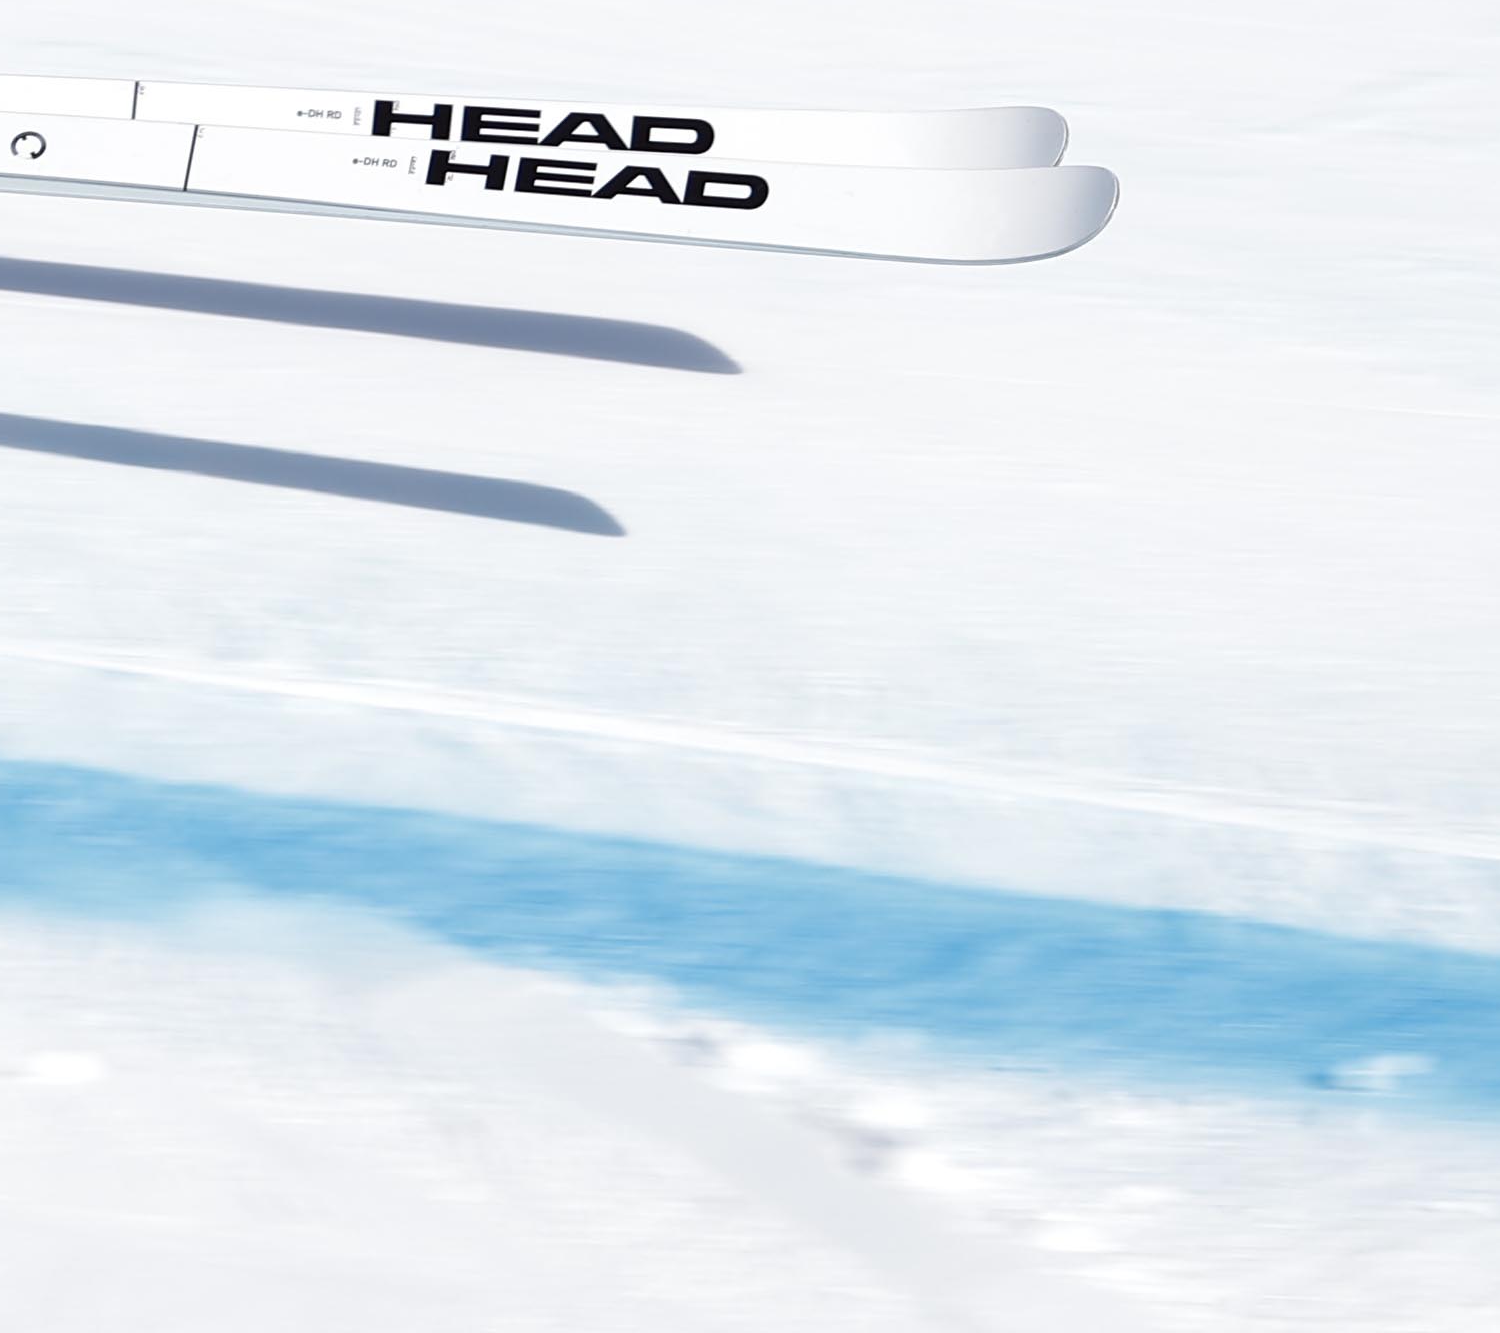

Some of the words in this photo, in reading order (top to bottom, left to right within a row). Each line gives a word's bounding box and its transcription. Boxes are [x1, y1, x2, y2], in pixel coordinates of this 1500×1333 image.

[327, 110, 342, 119] RD
[371, 99, 715, 155] HEAD
[382, 158, 397, 168] RD
[425, 149, 769, 210] HEAD
